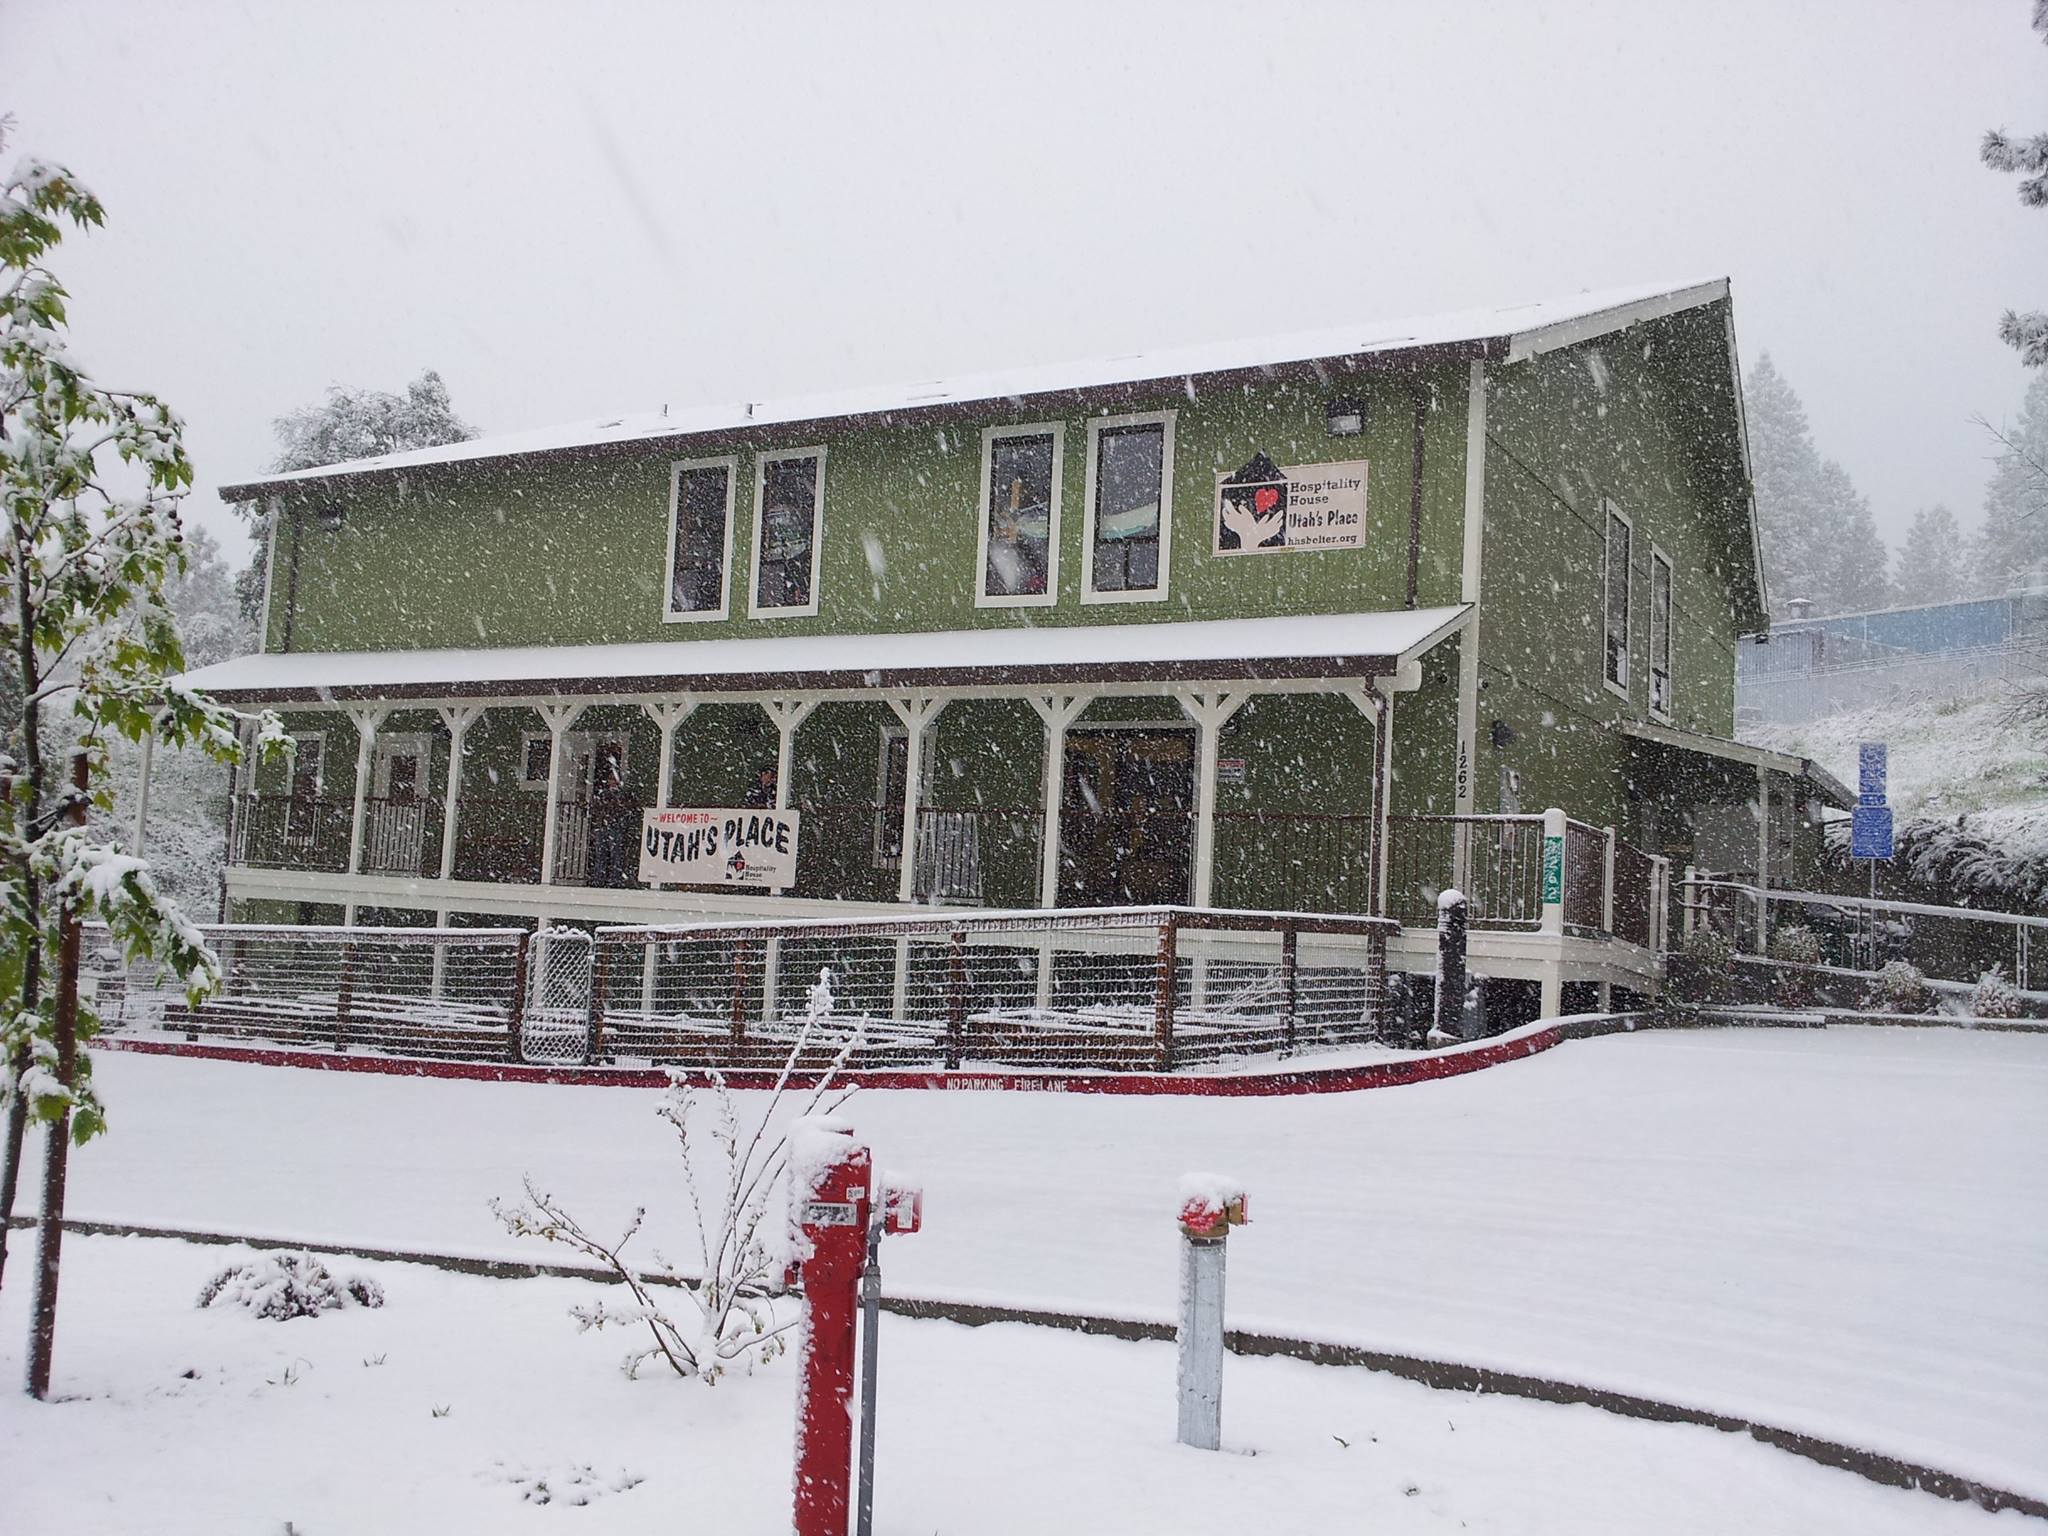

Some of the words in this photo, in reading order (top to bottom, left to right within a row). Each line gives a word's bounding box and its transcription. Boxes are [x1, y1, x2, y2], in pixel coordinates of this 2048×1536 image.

[1290, 478, 1361, 494] Hospitality
[1289, 495, 1329, 506] House
[1289, 510, 1323, 528] Utah's
[1327, 509, 1358, 526] Place
[1288, 535, 1357, 545] hhshelter.org
[1457, 740, 1468, 799] 1262
[659, 813, 698, 824] WELCOME
[700, 813, 710, 824] TO
[646, 825, 718, 863] UTAH'S
[724, 815, 790, 854] PLACE
[946, 1078, 960, 1090] NO
[960, 1078, 1004, 1091] PARKING
[1014, 1079, 1037, 1092] FIRE
[1040, 1079, 1068, 1092] LANE
